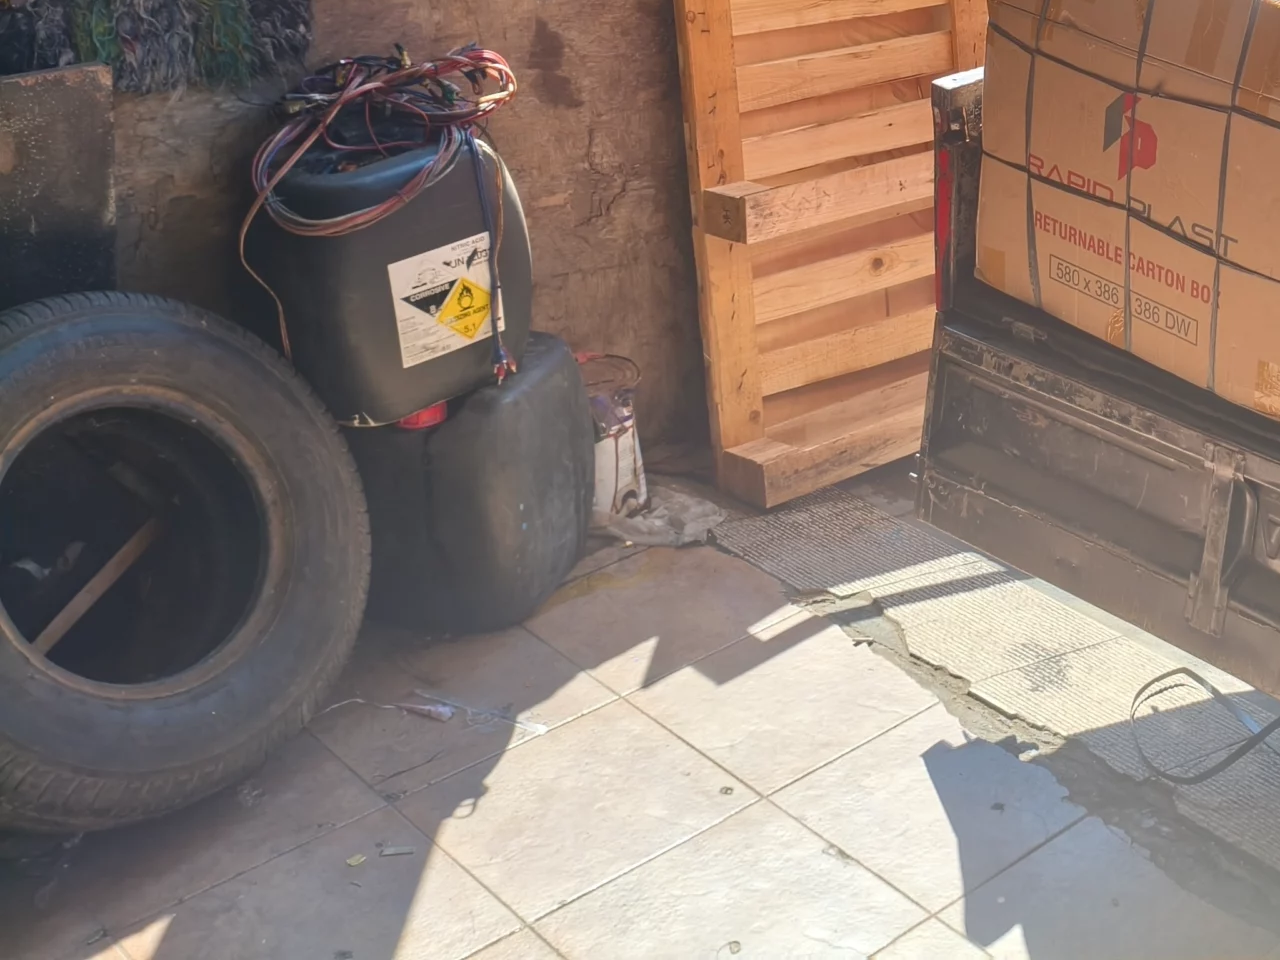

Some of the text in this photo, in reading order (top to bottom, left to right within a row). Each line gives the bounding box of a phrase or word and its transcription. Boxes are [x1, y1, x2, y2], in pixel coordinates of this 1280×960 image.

[1027, 153, 1115, 203] RAPID
[1034, 210, 1123, 266] RETURNABLE
[1128, 247, 1186, 293] CARTON
[410, 283, 450, 302] CORROSIVE
[1055, 263, 1191, 337] 580 x 386 386 DW
[463, 323, 477, 333] 5.1
